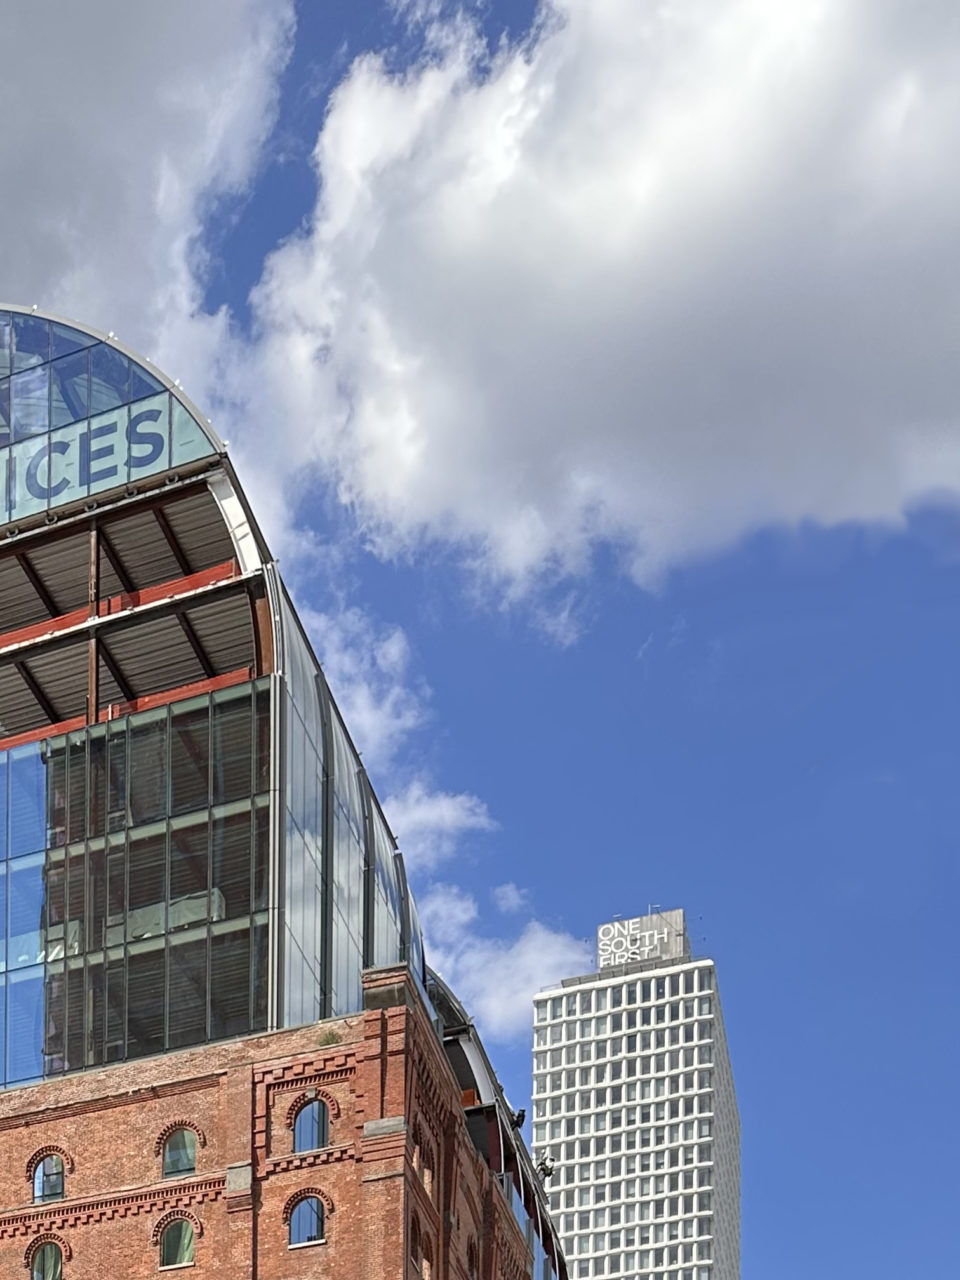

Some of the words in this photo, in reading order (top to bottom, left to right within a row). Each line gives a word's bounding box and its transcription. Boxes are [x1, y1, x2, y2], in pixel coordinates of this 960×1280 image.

[598, 918, 641, 940] ONE
[598, 927, 668, 955] SOUTH
[599, 945, 654, 968] FIRST
